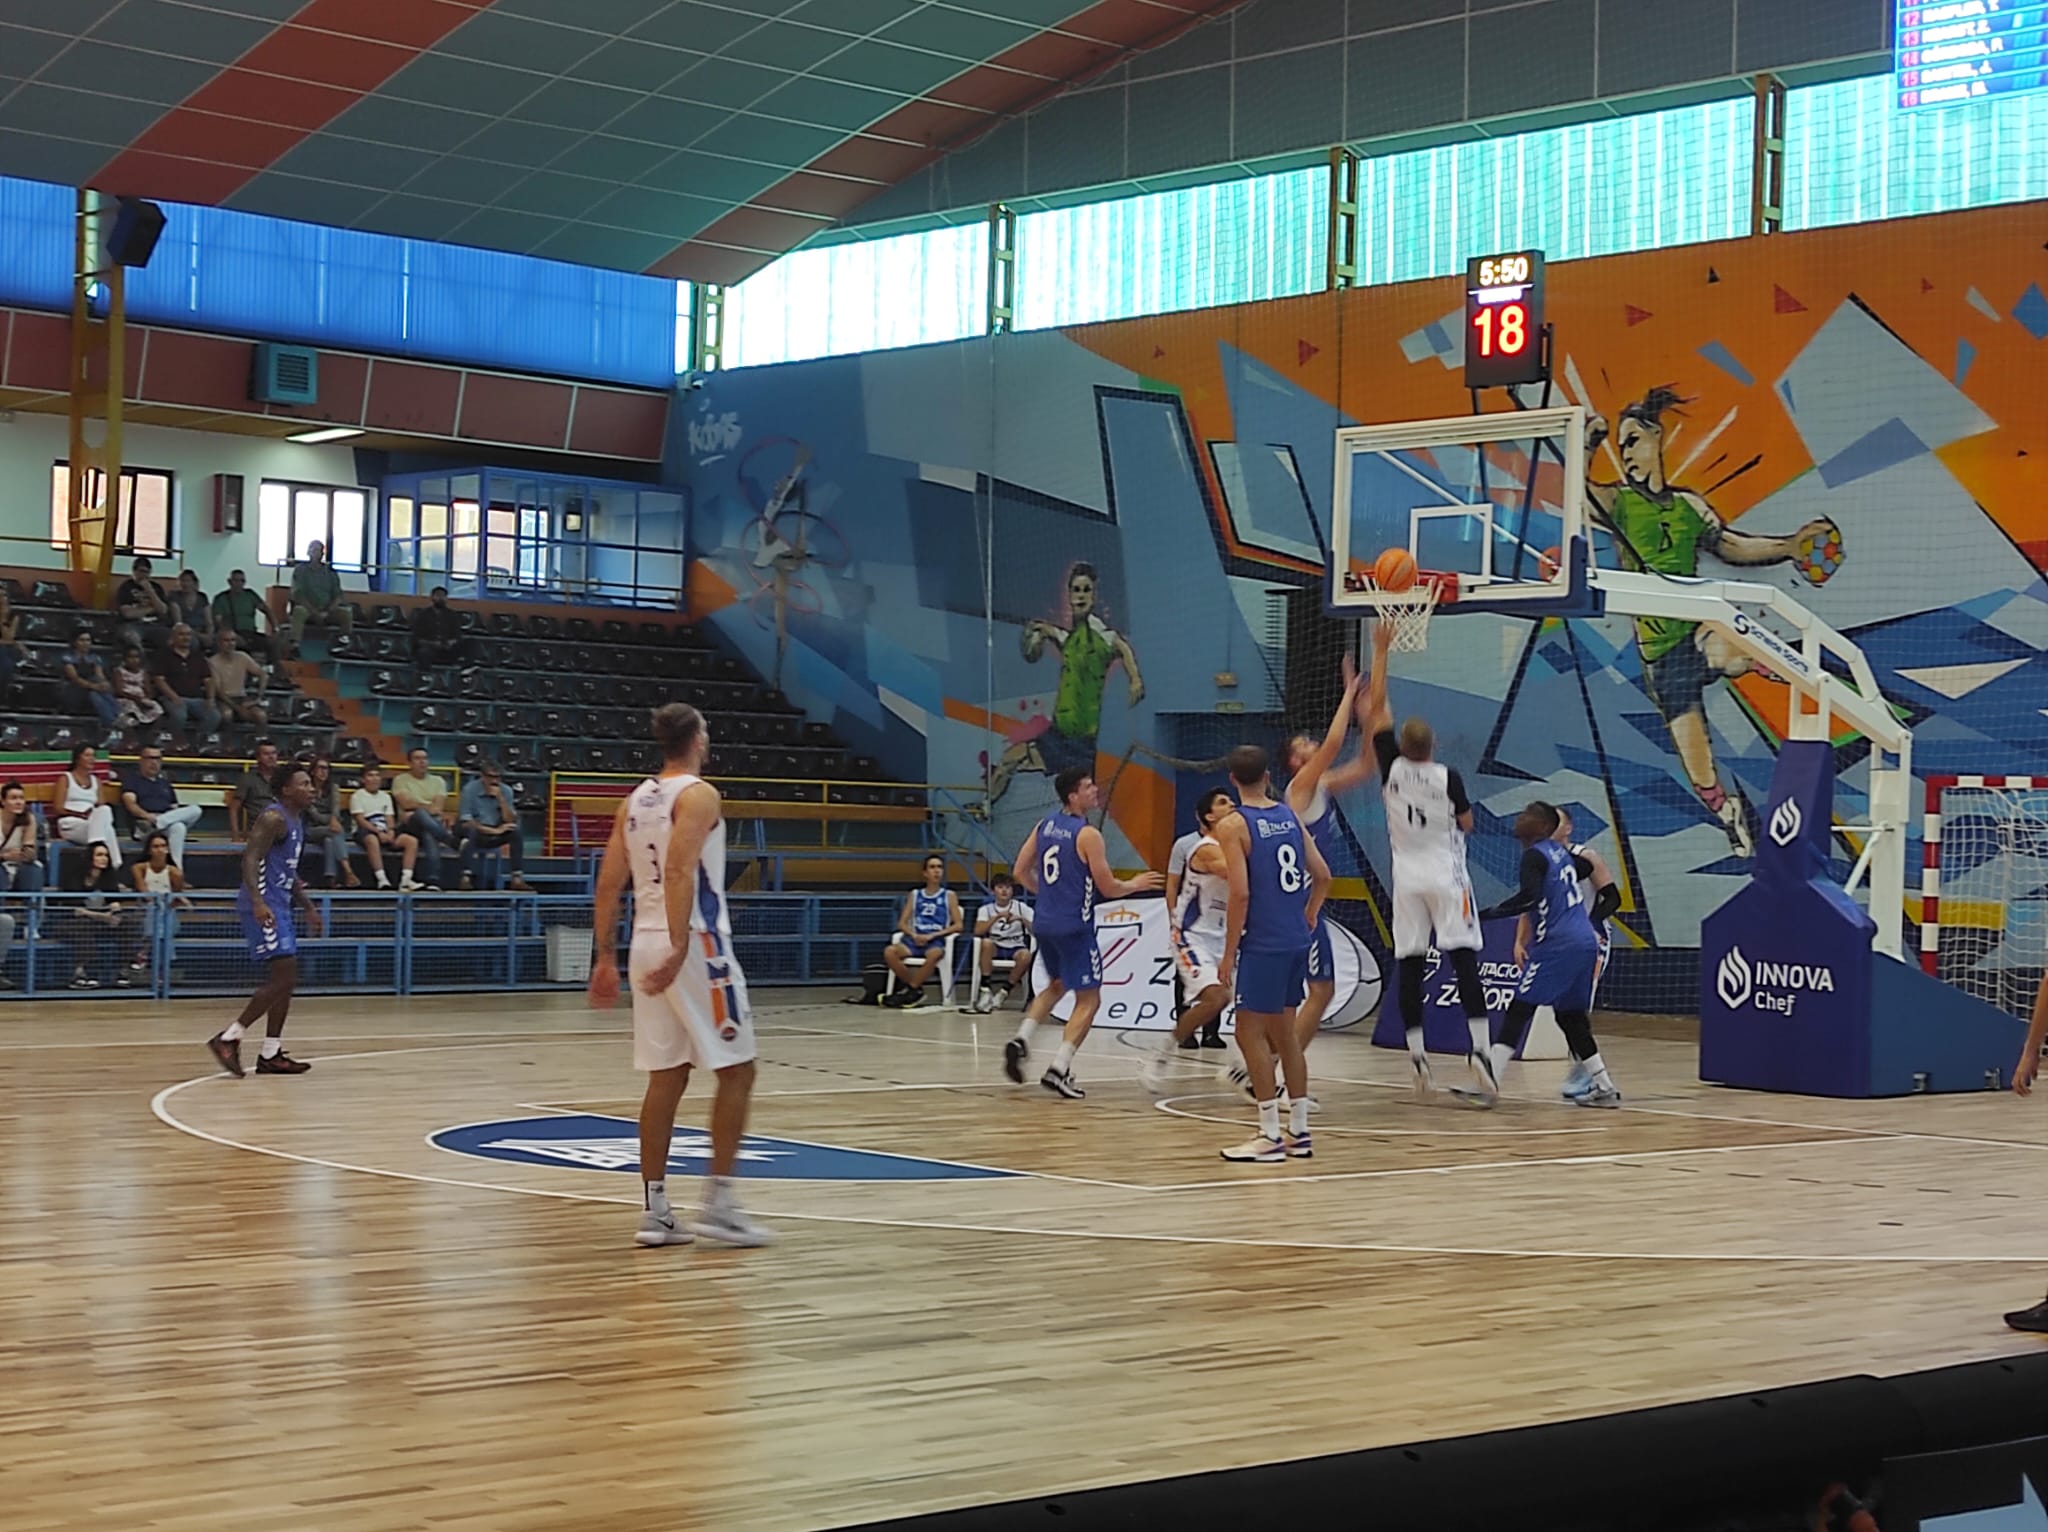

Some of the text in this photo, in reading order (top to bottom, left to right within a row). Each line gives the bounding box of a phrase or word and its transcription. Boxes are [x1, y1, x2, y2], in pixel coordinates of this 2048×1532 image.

[1479, 257, 1528, 286] 5:50
[1474, 305, 1524, 356] 18
[1043, 844, 1060, 885] 6
[1277, 844, 1301, 892] 8
[1755, 961, 1834, 992] INNOVA
[1755, 991, 1796, 1016] Chef
